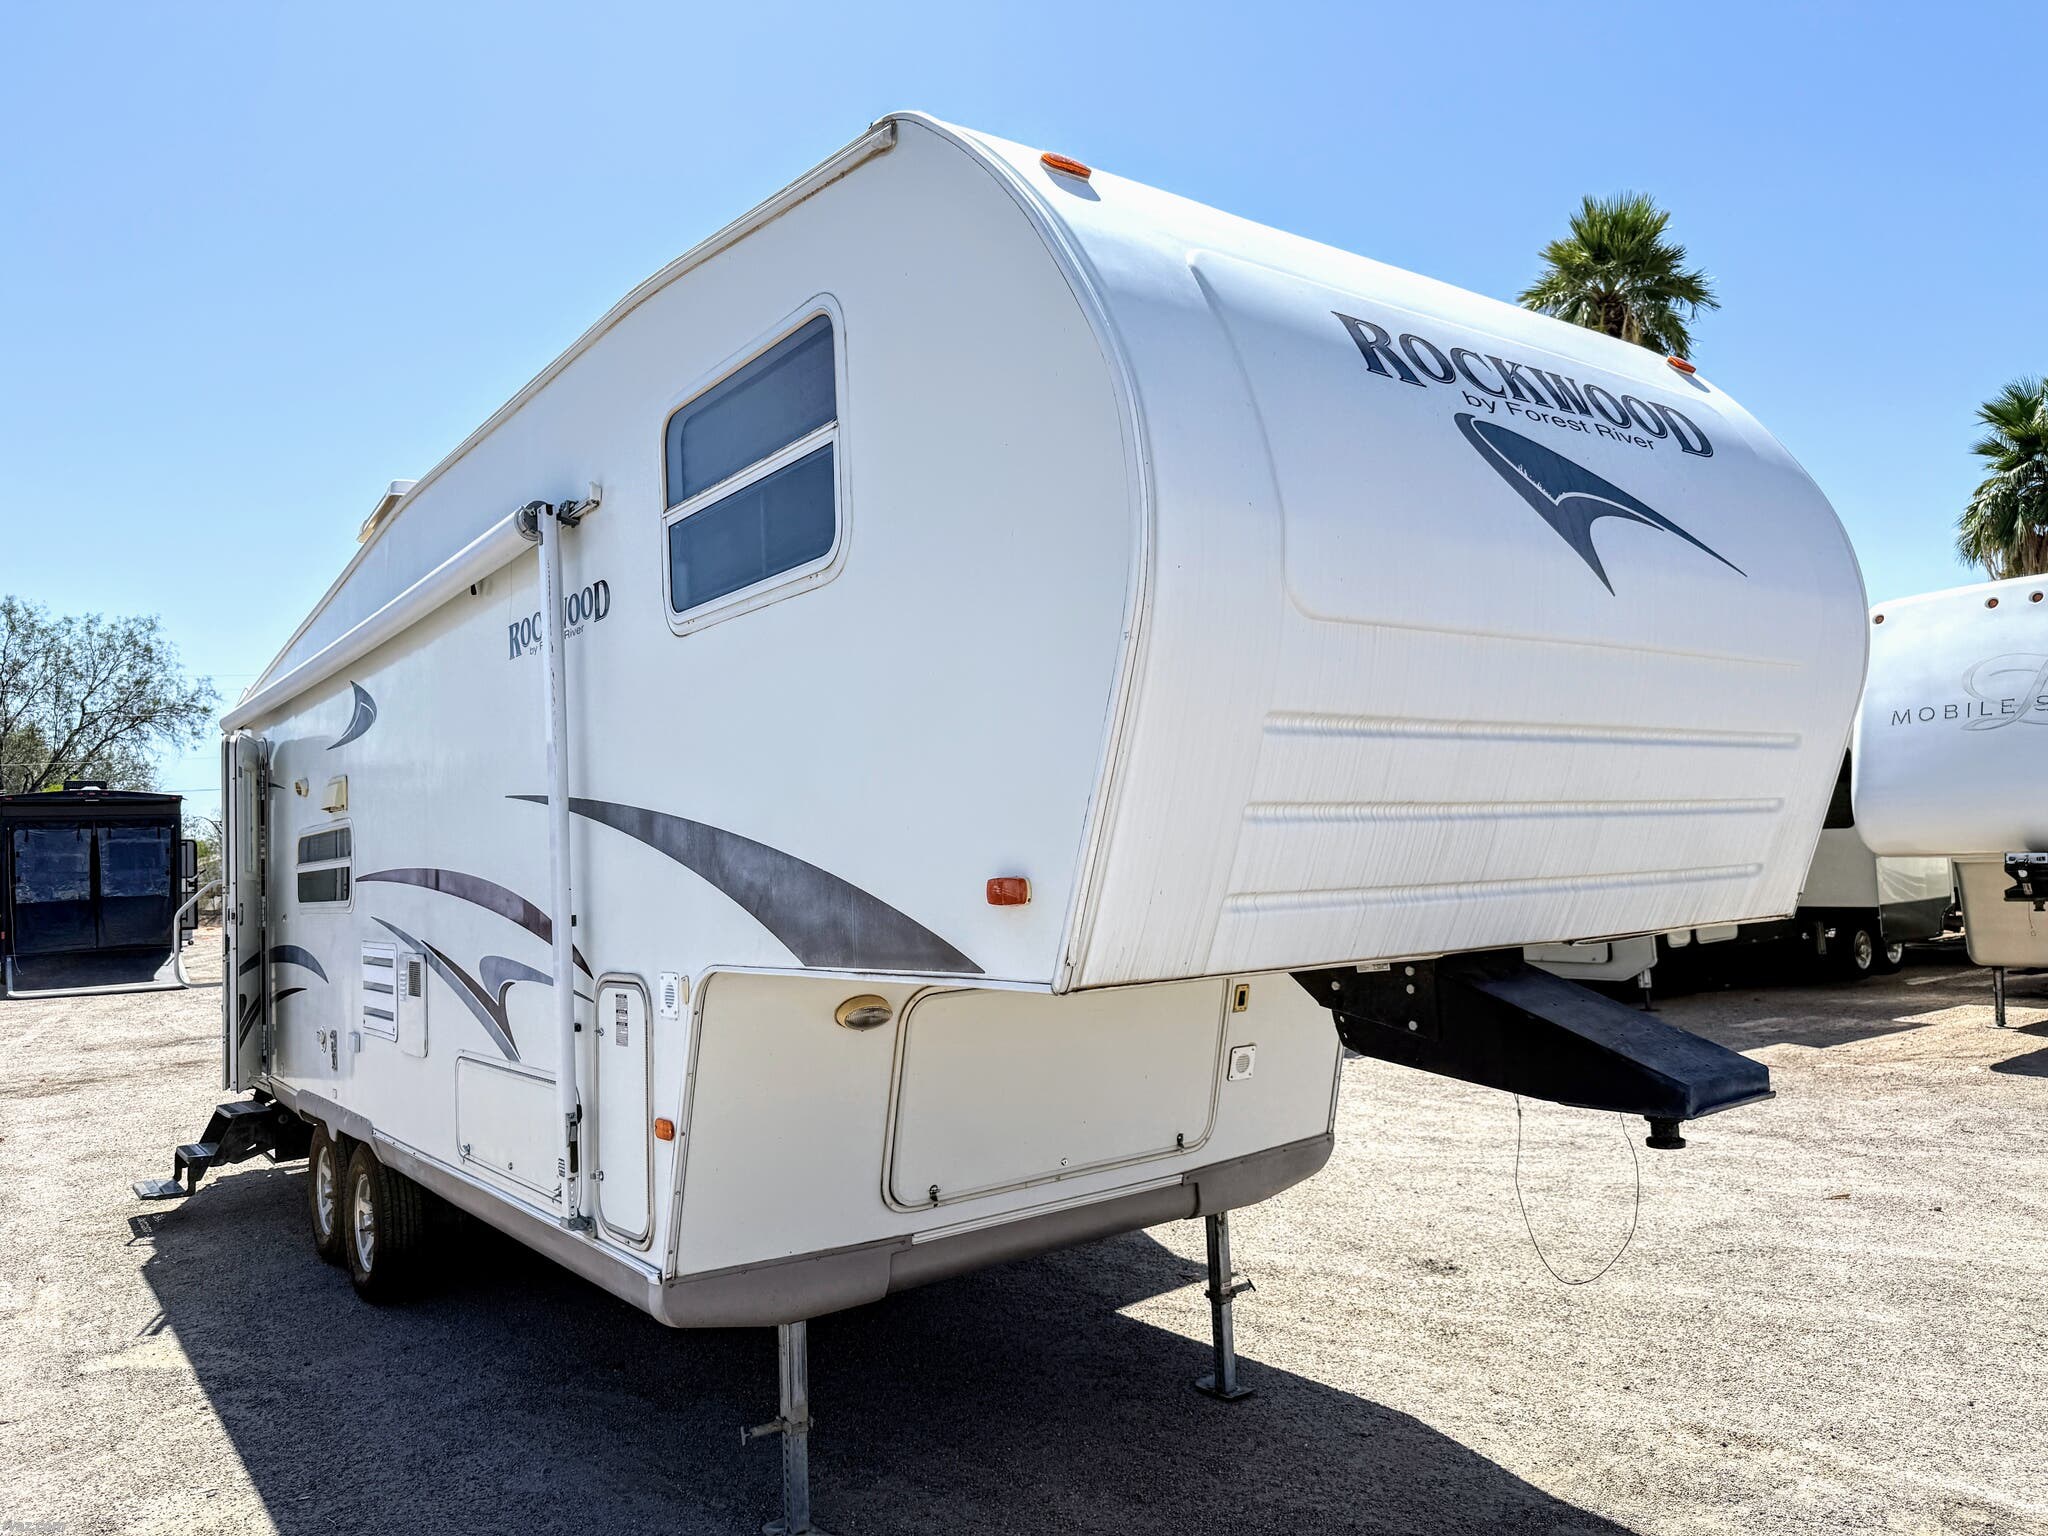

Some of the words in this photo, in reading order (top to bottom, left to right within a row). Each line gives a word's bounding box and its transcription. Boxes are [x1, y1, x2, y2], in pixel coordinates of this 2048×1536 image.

[1330, 310, 1714, 458] ROCKWOOD
[1462, 390, 1496, 414] by
[1505, 401, 1591, 434] Forest
[1594, 422, 1654, 450] River
[508, 579, 611, 661] ROCOOD
[529, 645, 538, 656] by
[1891, 698, 2016, 726] MOBILE
